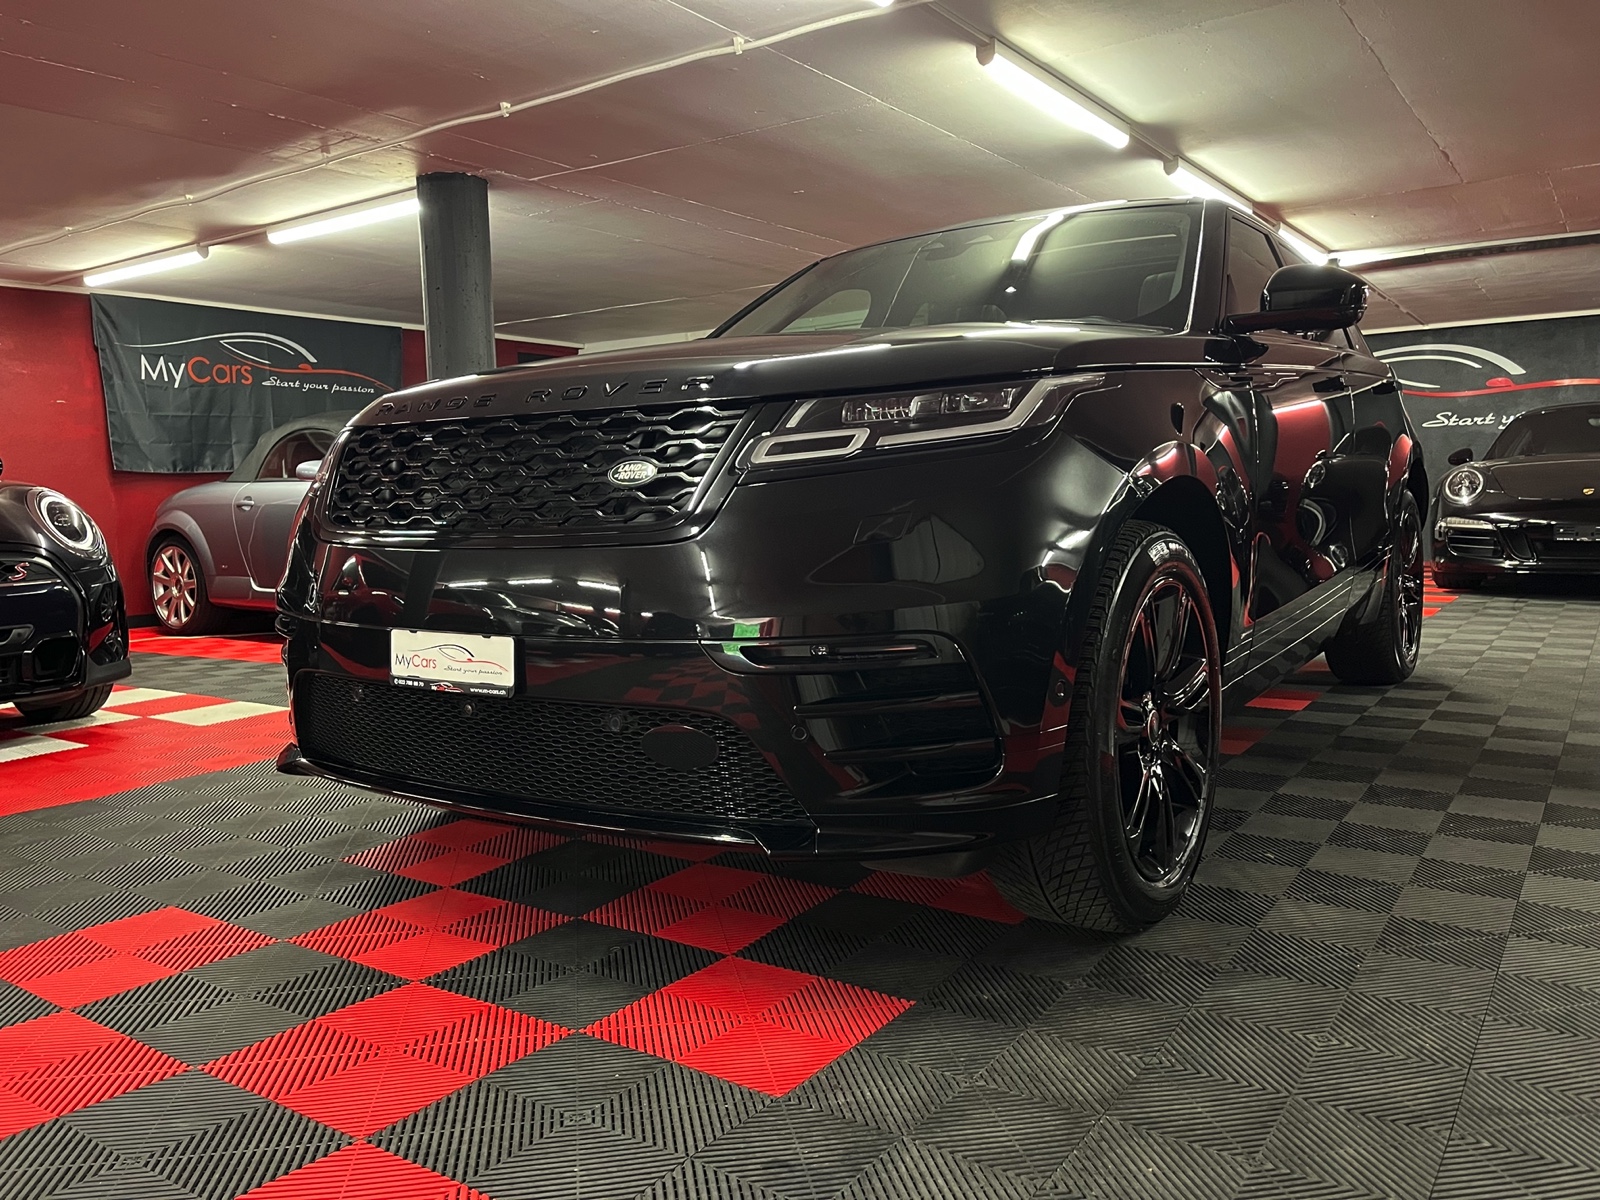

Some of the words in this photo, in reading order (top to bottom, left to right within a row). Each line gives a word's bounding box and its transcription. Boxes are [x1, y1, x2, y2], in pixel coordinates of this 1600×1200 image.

[140, 354, 253, 388] MyCars
[262, 376, 301, 389] Start
[302, 378, 329, 392] your
[331, 382, 375, 394] passion
[374, 395, 496, 416] RANGE
[526, 375, 715, 403] ROVER
[1422, 411, 1495, 428] Start
[618, 463, 643, 473] LAND
[618, 471, 647, 480] ROVER
[395, 653, 437, 669] MyCars
